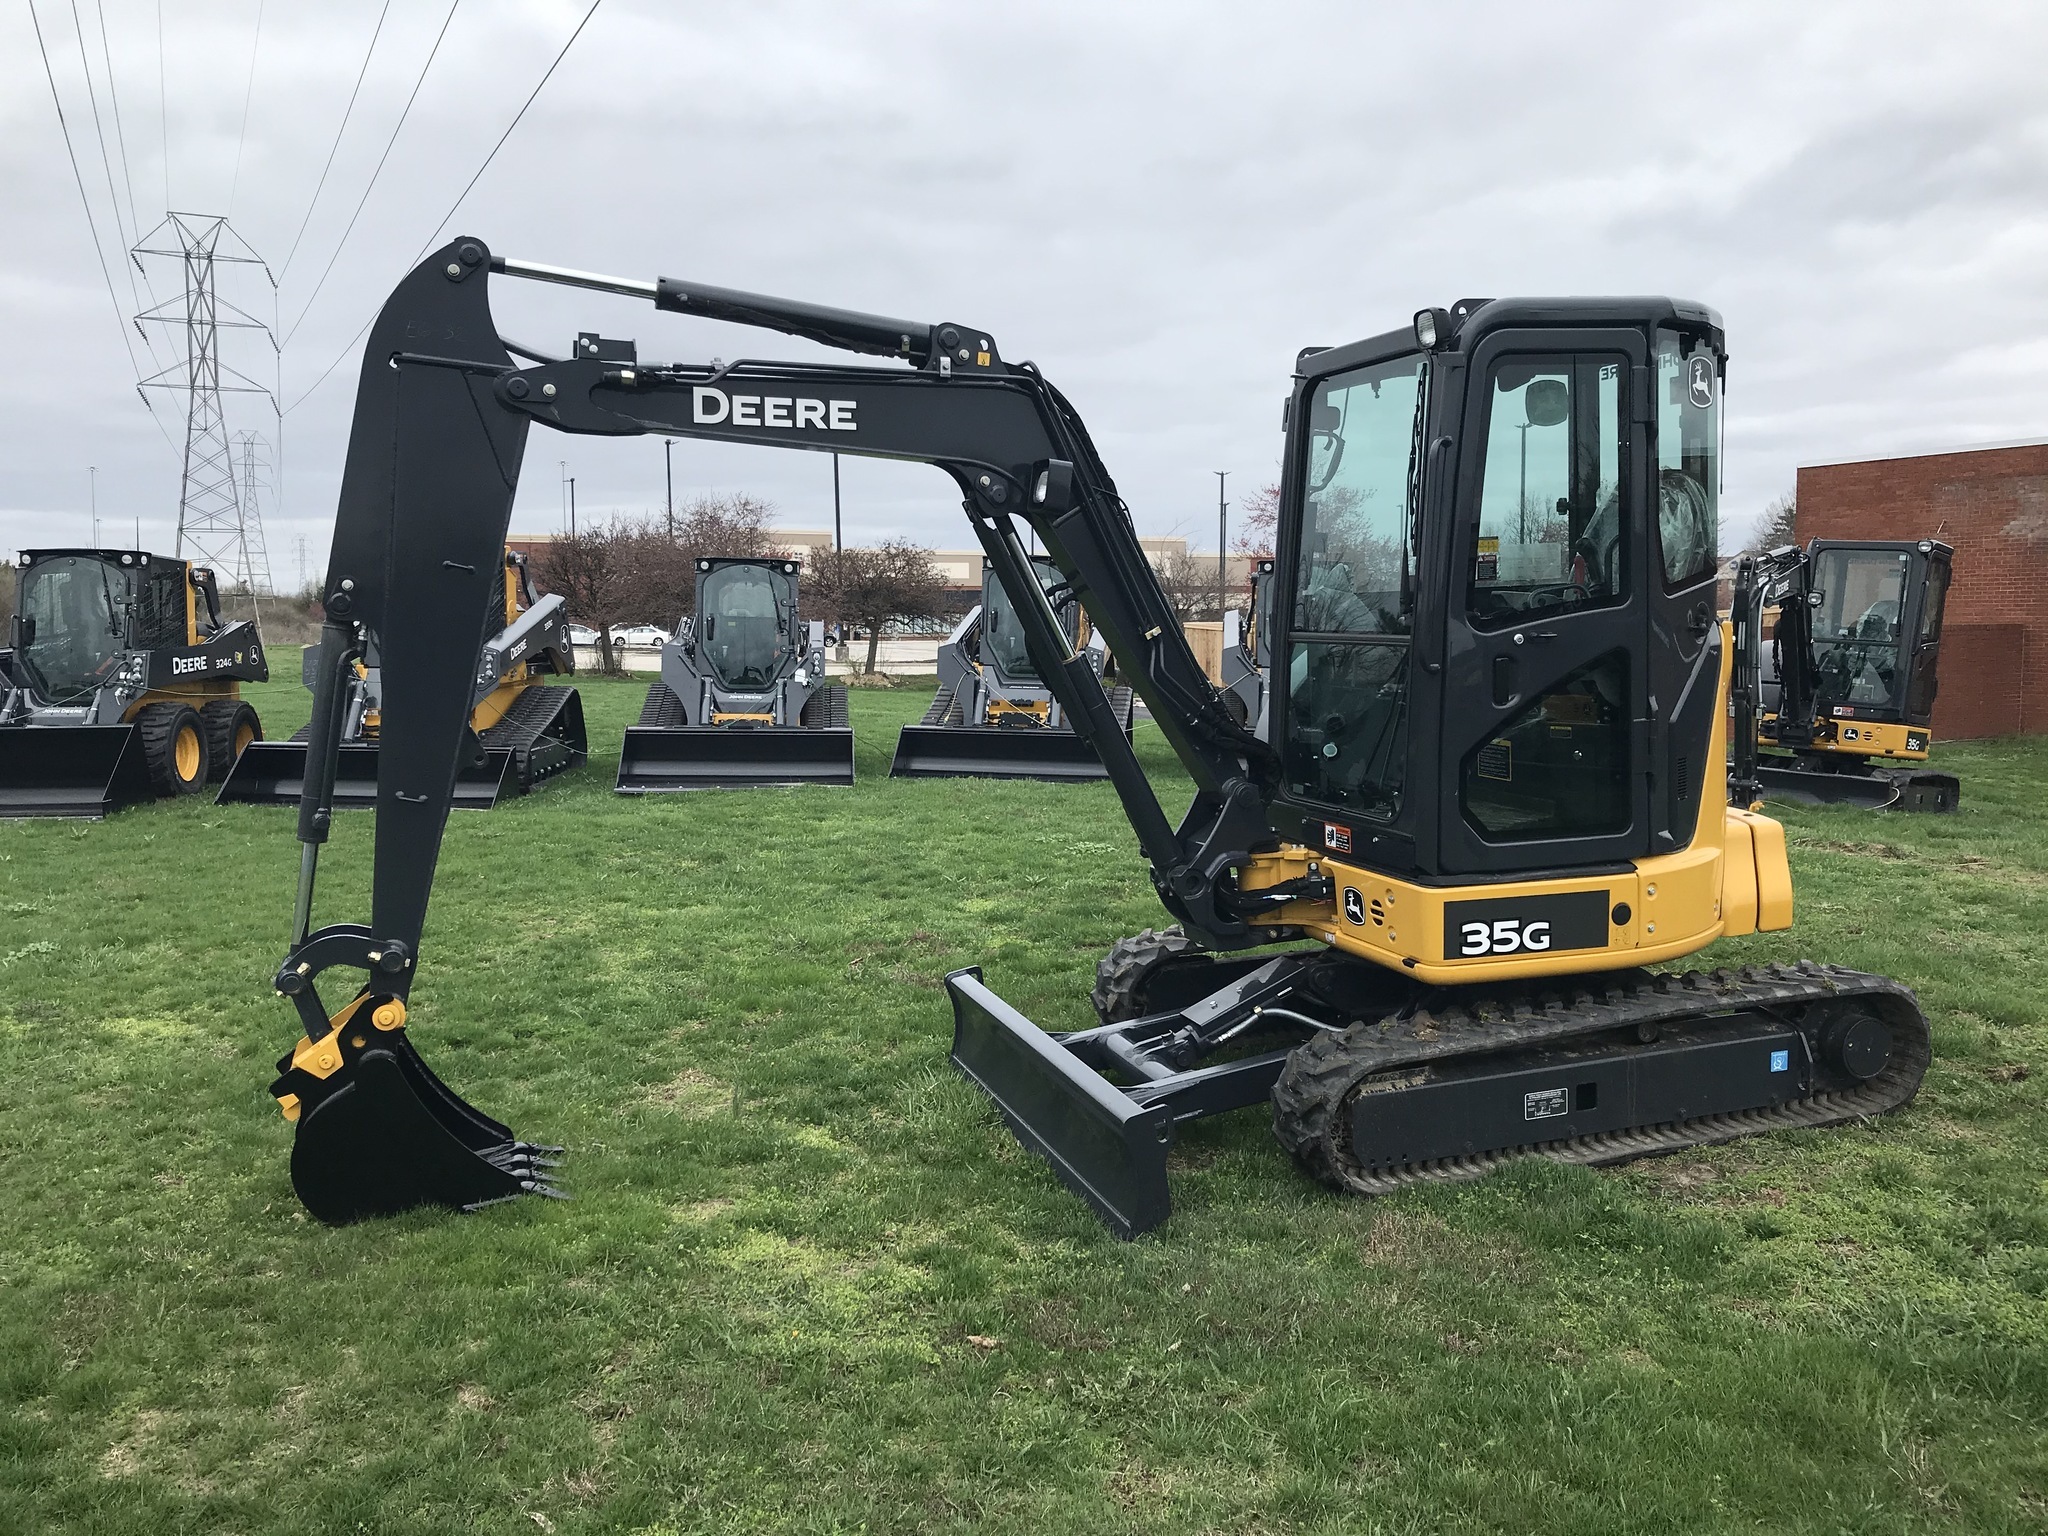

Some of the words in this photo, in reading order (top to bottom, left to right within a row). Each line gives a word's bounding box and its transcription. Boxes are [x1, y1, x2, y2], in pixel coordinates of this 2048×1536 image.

[692, 386, 857, 431] DEERE
[510, 638, 528, 661] DEERE
[172, 655, 207, 675] DEERE
[215, 658, 232, 669] 324G
[1907, 738, 1920, 750] 35G
[1461, 919, 1550, 956] 35G
